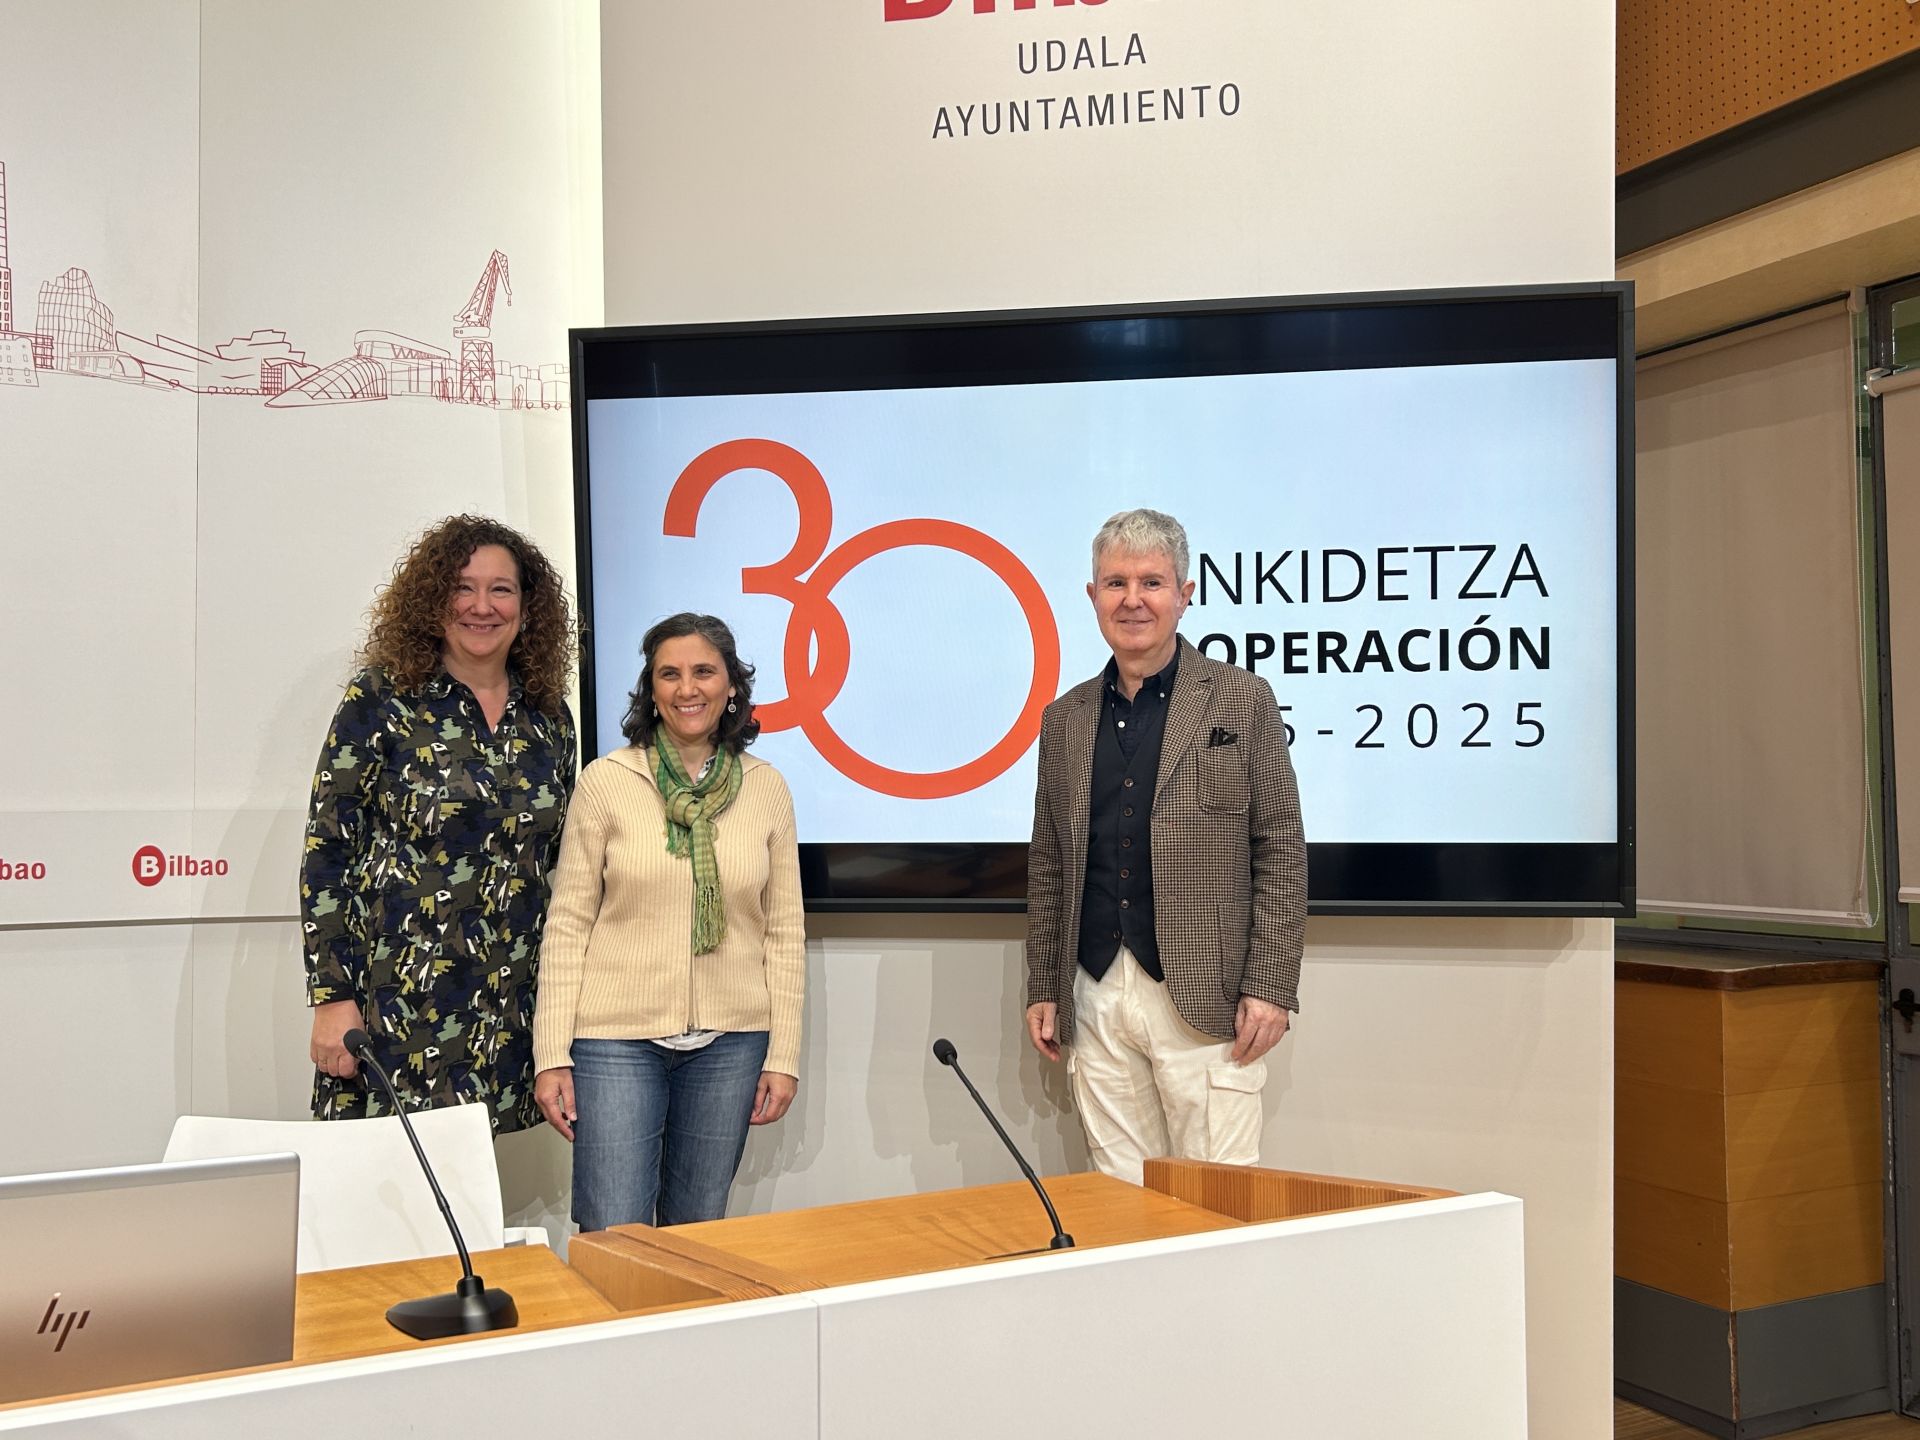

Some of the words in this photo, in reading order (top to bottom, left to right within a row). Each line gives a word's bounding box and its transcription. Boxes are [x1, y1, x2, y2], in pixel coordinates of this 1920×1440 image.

[1018, 33, 1147, 75] UDALA
[932, 83, 1241, 139] AYUNTAMIENTO
[1188, 543, 1549, 606] NKIDETZA
[663, 438, 1061, 799] 30
[139, 854, 229, 878] Bilbao
[37, 1292, 91, 1353] hp
